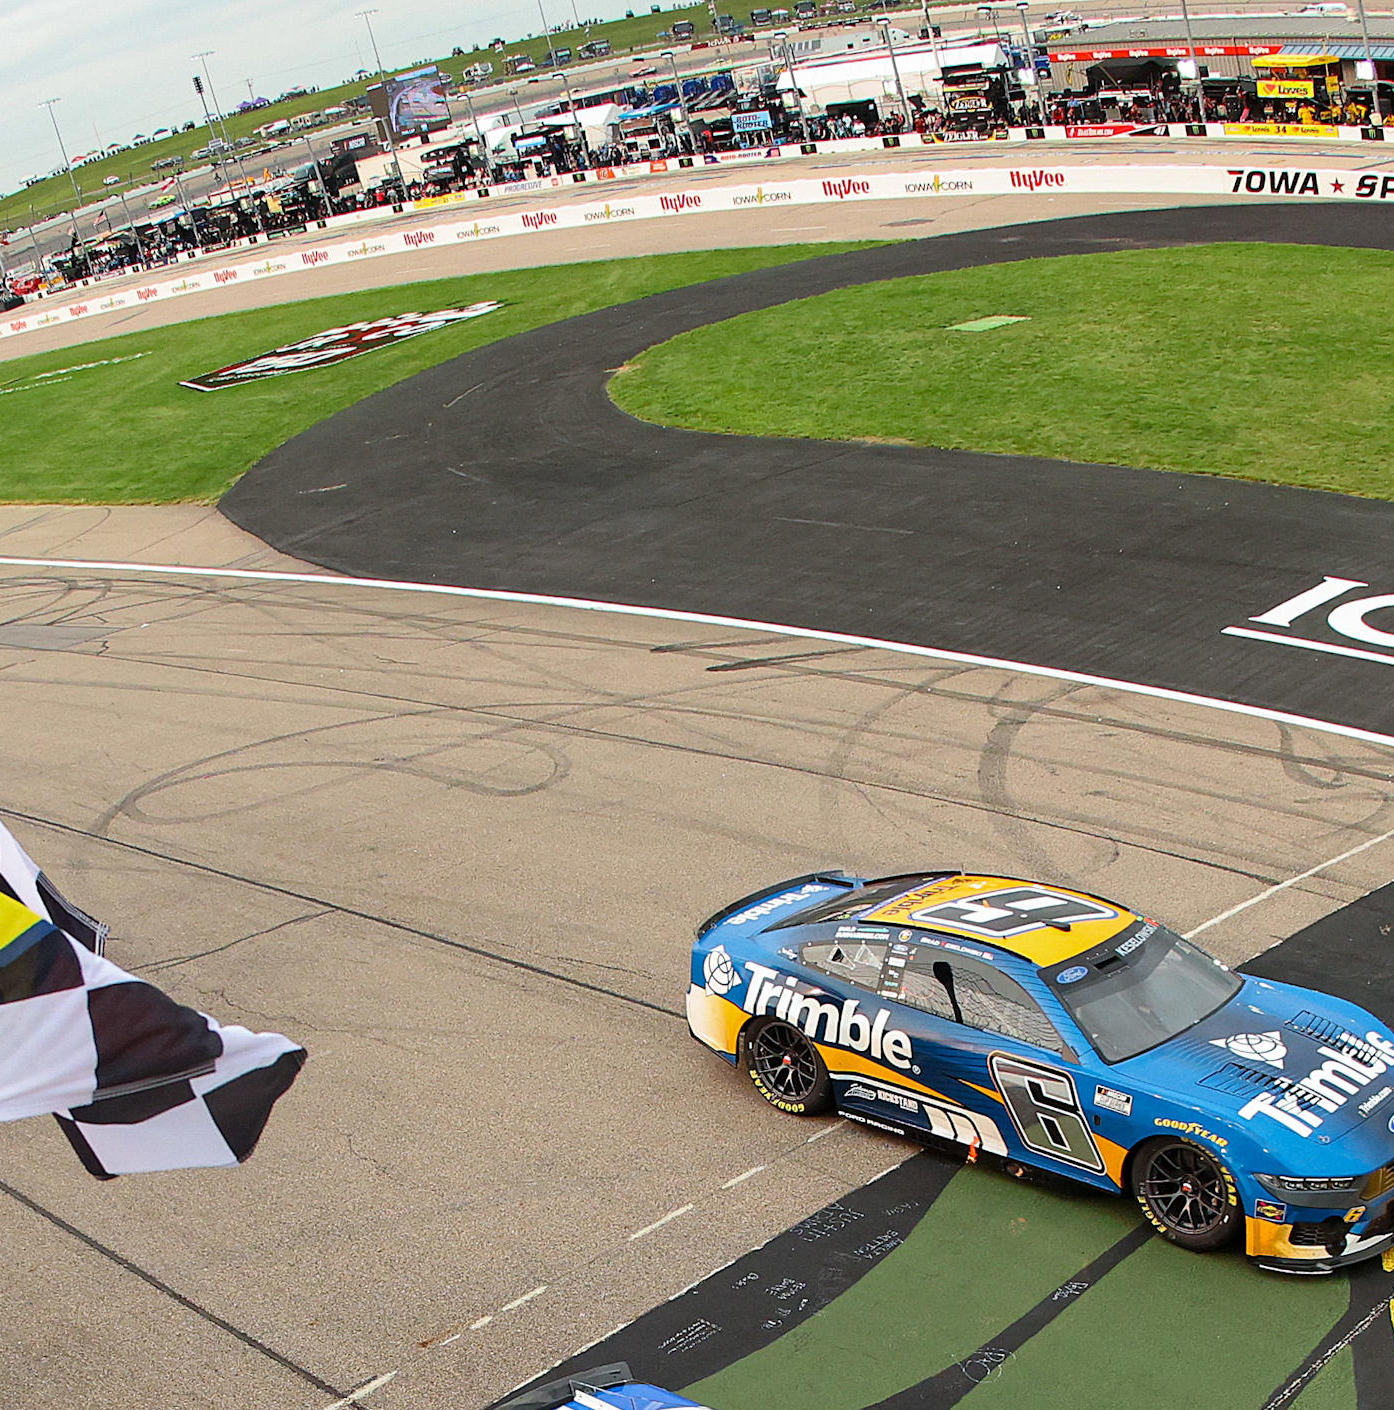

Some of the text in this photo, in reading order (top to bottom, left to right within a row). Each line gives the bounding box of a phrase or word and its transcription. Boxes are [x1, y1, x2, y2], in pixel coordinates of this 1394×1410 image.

[720, 150, 762, 161] ROTO-ROOTER
[504, 180, 542, 193] PROGRESSIVE
[822, 178, 870, 200] HyVee
[904, 180, 974, 194] IOWA CORN
[1009, 170, 1066, 192] HyVee
[1227, 169, 1320, 196] IOWA
[659, 194, 702, 213] HyVee
[732, 191, 792, 205] IOWA CORN
[521, 211, 558, 230] HyVee
[584, 207, 635, 222] IOWA CORN
[403, 231, 435, 248] HyVee
[742, 960, 913, 1075] Trimble
[987, 1048, 1107, 1177] 6
[837, 1110, 905, 1136] FORD RACING
[1153, 1116, 1229, 1148] GOODYEAR
[1342, 1205, 1367, 1224] 6
